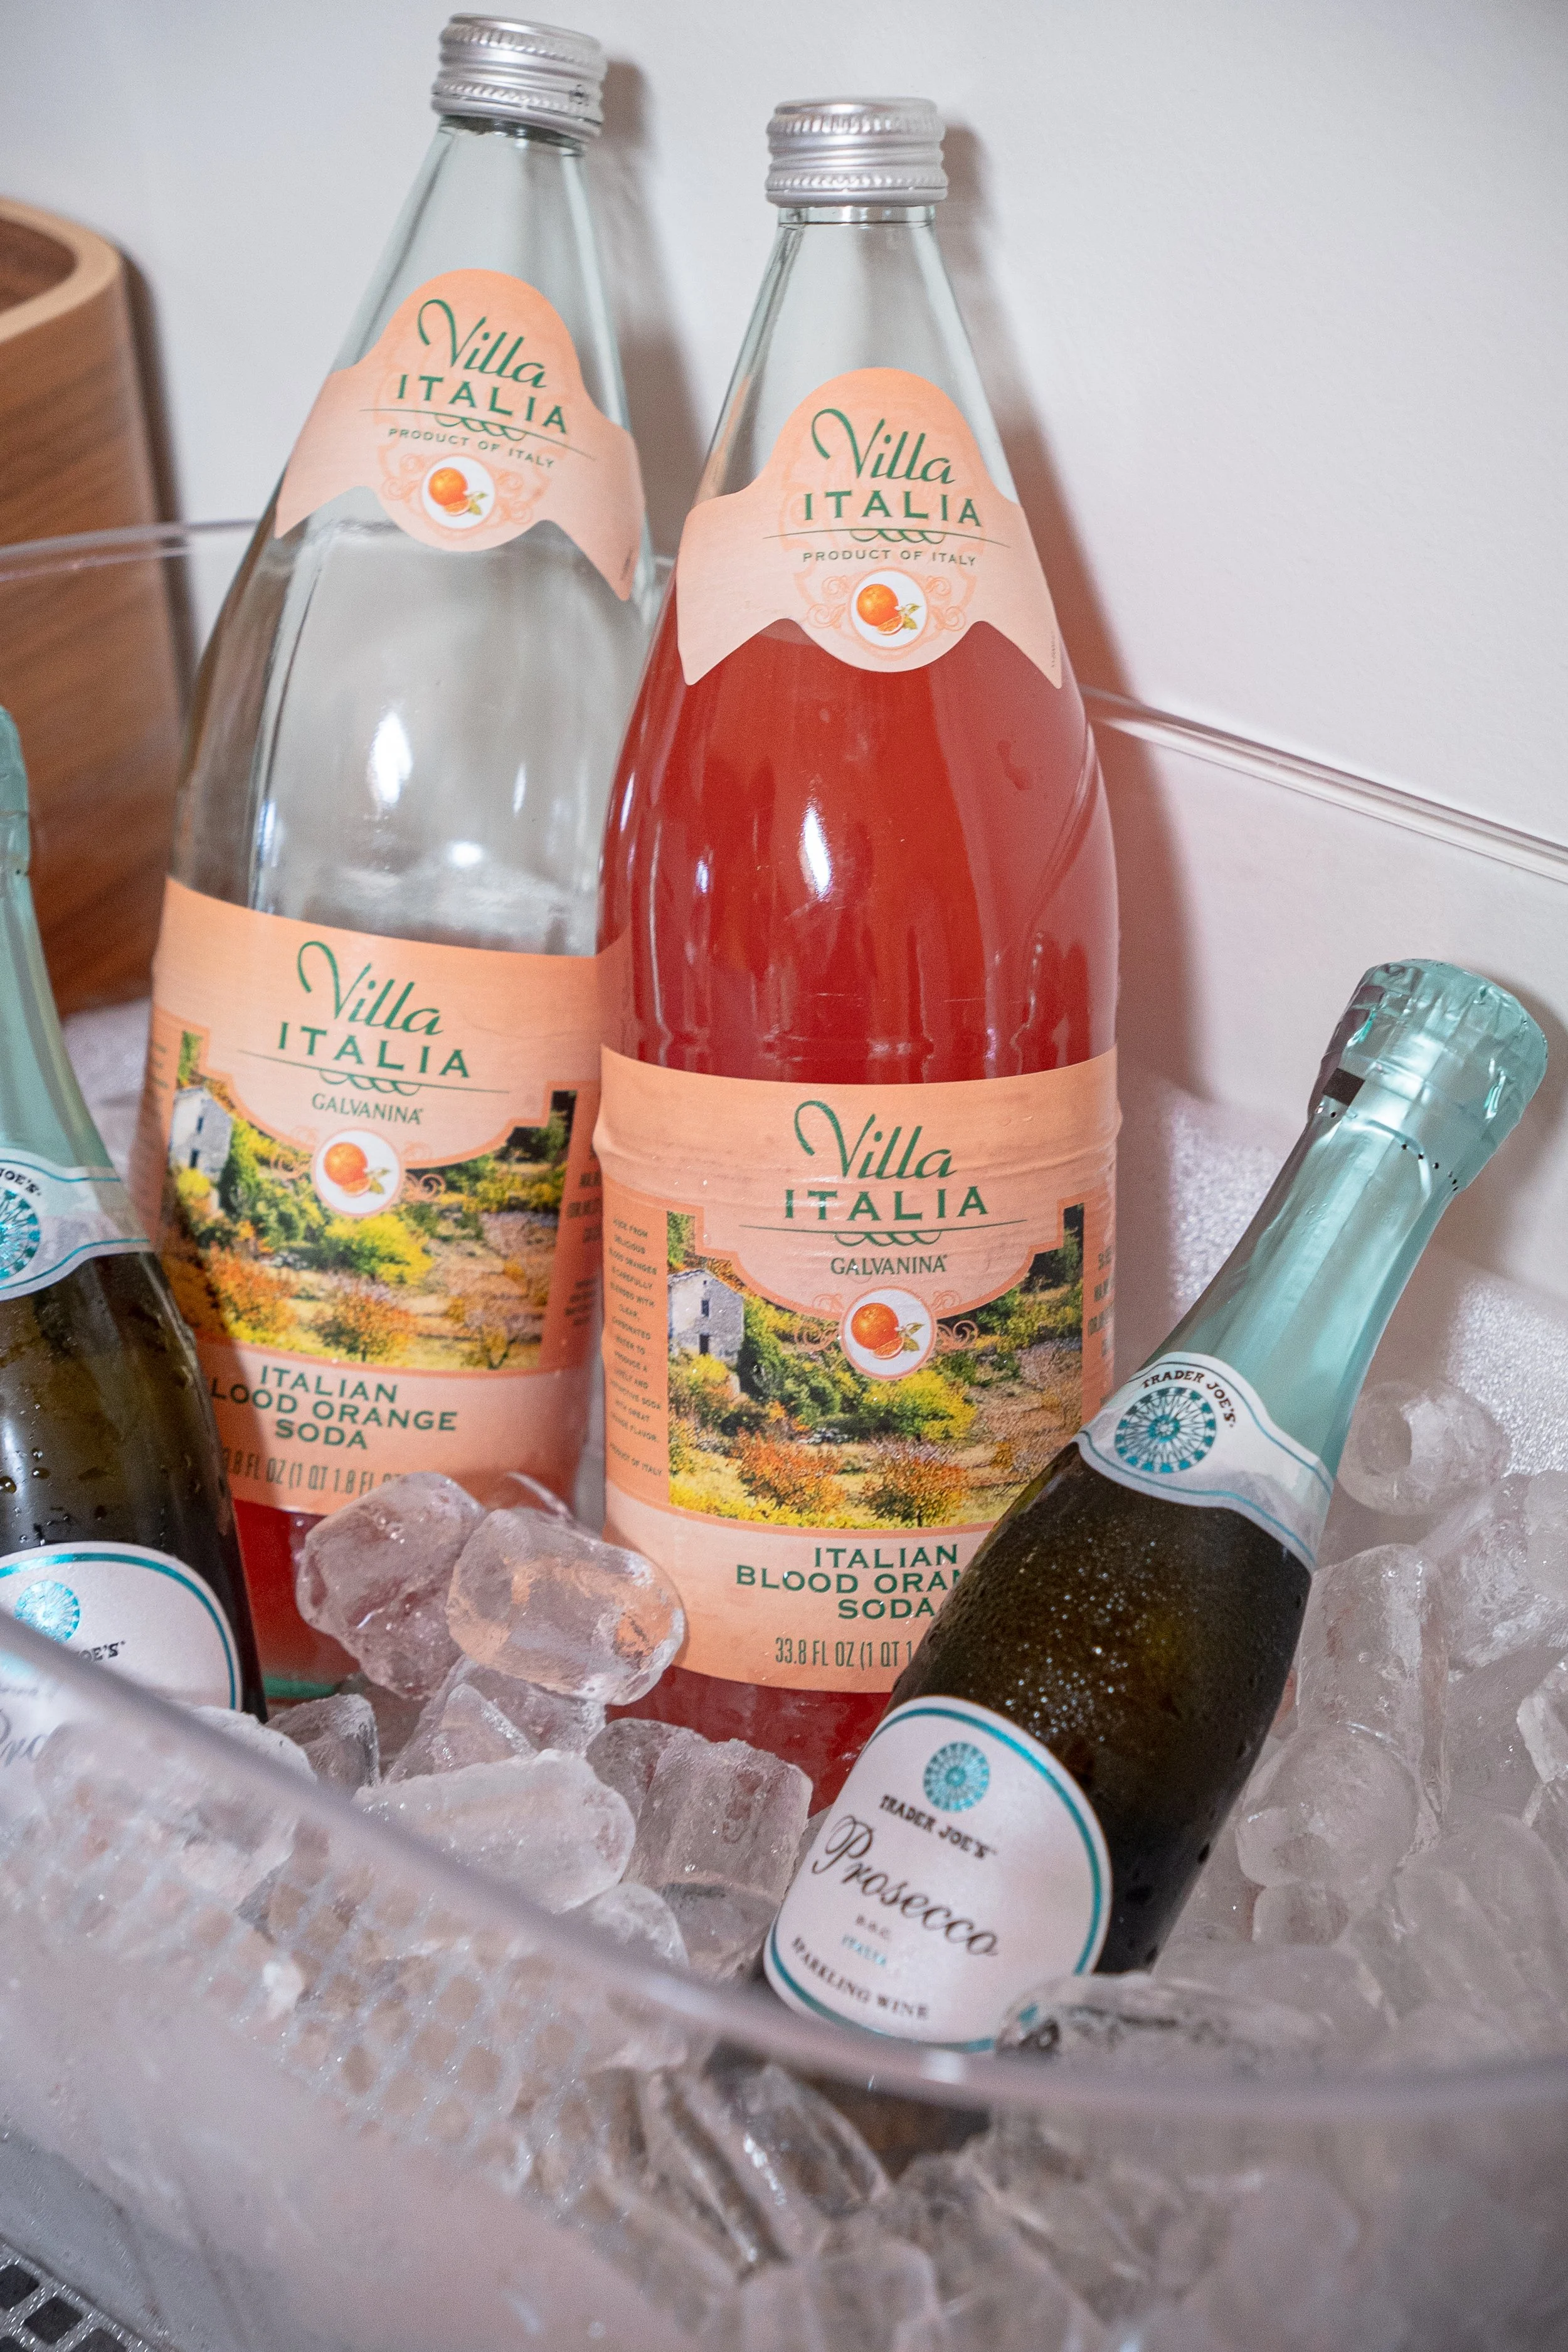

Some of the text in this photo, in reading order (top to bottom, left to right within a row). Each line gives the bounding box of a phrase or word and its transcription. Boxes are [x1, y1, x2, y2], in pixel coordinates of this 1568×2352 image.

[418, 299, 546, 388] Villa
[396, 374, 568, 434] ITALIA
[388, 428, 555, 469] PRODUCT OF ITALY
[812, 408, 956, 484] Villa
[803, 490, 982, 527] ITALIA
[803, 549, 976, 566] PRODUCT OF ITALY
[297, 941, 443, 1036] Villa
[277, 1022, 470, 1078] ITALIA
[793, 1099, 956, 1180] Villa
[785, 1185, 988, 1221] ITALIA
[260, 1365, 398, 1404] ITALIAN
[1142, 1370, 1204, 1389] TRADER
[211, 1378, 457, 1432] LOOD ORANGE
[275, 1419, 368, 1450] SODA
[308, 1465, 328, 1490] QT
[815, 1544, 957, 1569] ITALIAN
[736, 1565, 960, 1594] BLOOD ORA
[838, 1597, 935, 1620] SODA
[79, 1641, 119, 1661] OE'S
[775, 1636, 807, 1665] 33.8
[812, 1640, 829, 1666] FL
[835, 1640, 854, 1667] OZ
[861, 1641, 872, 1671] (1
[881, 1641, 899, 1667] QT
[879, 1794, 934, 1833] TRADER
[812, 1815, 999, 1956] Prosecco
[792, 1937, 930, 2020] SPARKLING WINE
